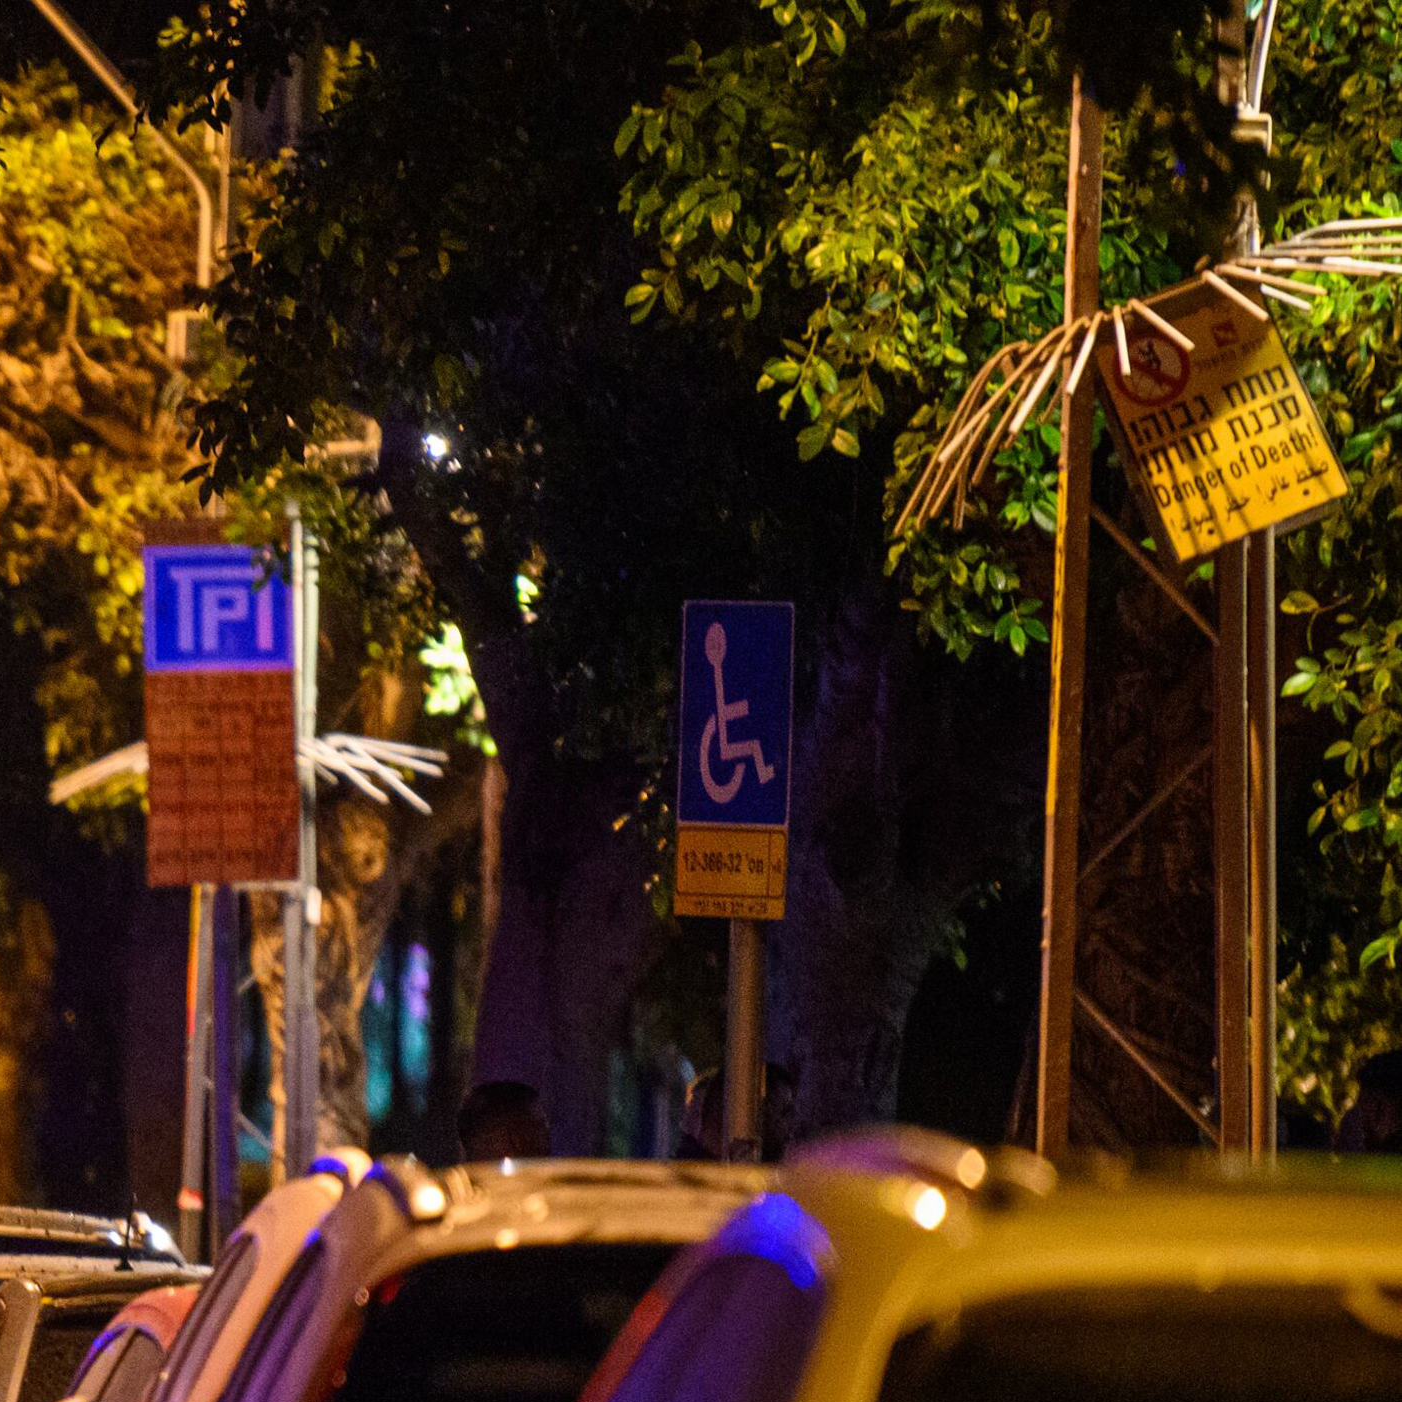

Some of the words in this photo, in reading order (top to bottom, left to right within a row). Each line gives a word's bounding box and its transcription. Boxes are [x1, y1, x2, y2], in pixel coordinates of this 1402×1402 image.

[1222, 365, 1290, 409] מתח
[1227, 394, 1302, 443] סכנת
[1152, 467, 1225, 509] Danger
[1229, 450, 1251, 480] of
[1250, 423, 1320, 470] Death!
